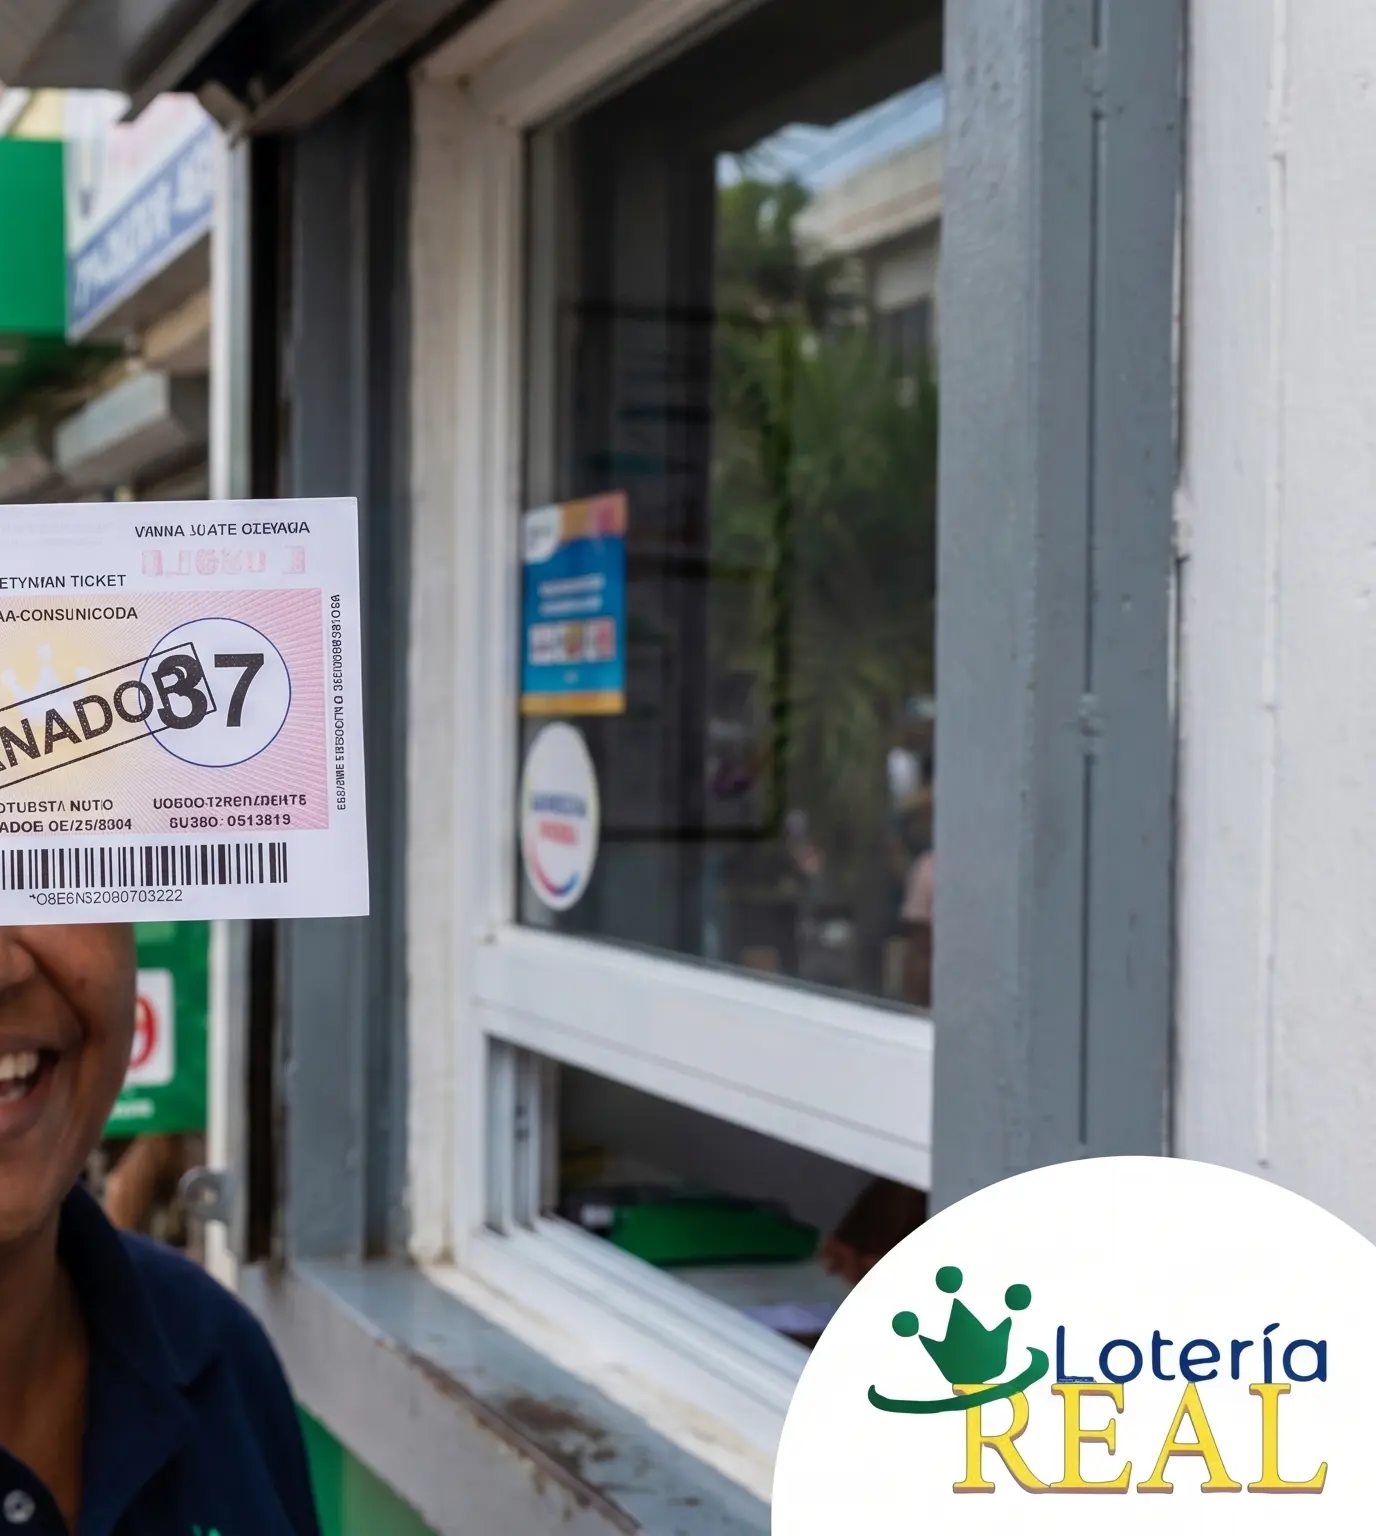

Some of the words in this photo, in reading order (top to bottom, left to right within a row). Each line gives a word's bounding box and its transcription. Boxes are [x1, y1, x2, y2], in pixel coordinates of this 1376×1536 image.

[135, 525, 185, 537] VANNA
[71, 574, 126, 587] TICKET
[157, 653, 265, 729] 37
[227, 814, 291, 827] 0513819
